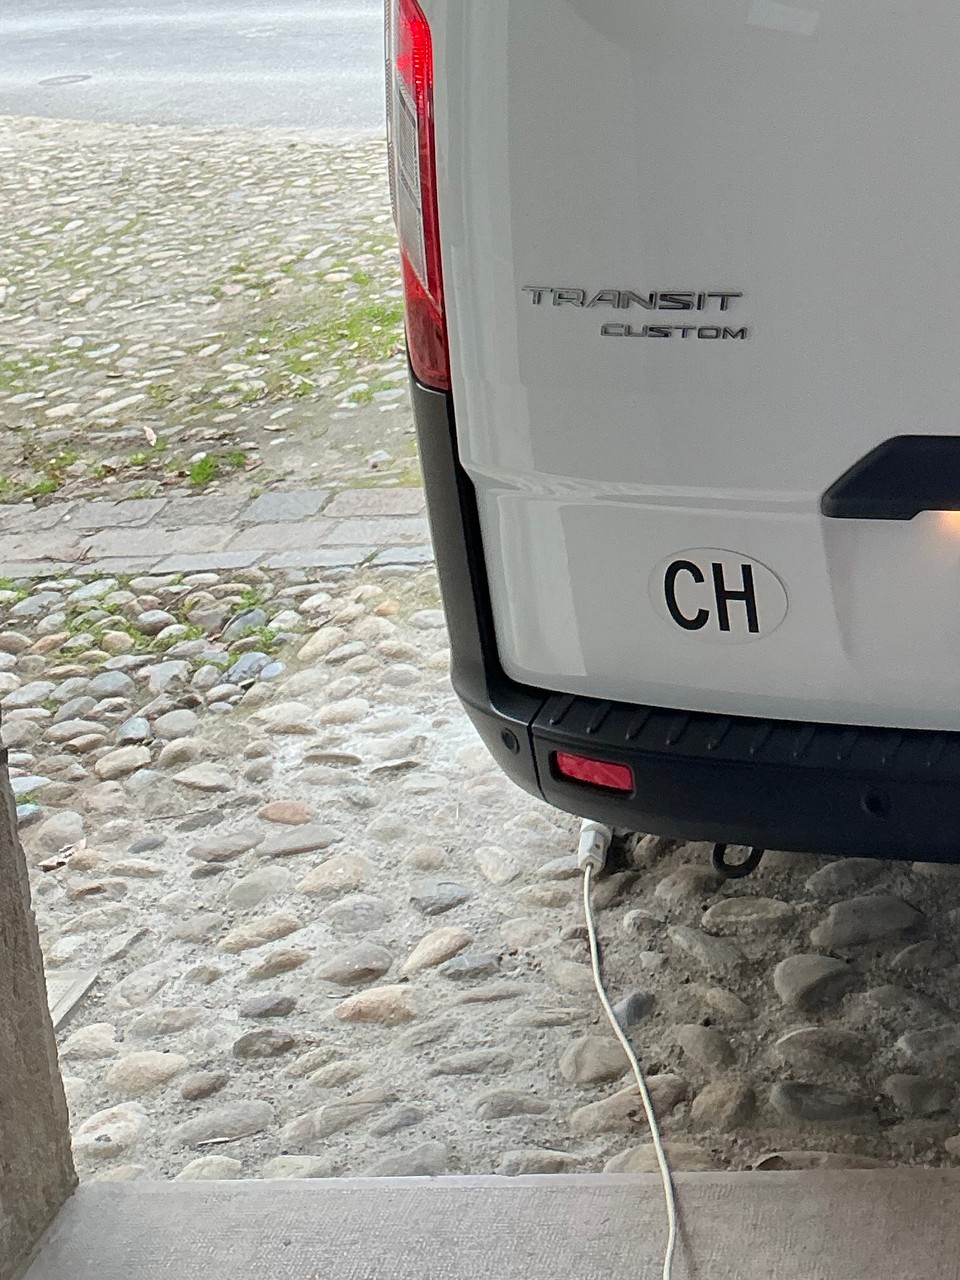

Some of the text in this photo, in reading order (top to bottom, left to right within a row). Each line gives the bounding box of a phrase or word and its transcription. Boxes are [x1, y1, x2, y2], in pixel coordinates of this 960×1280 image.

[521, 285, 743, 311] TRANSIT
[600, 323, 748, 340] CUSTOM
[664, 559, 760, 634] CH
